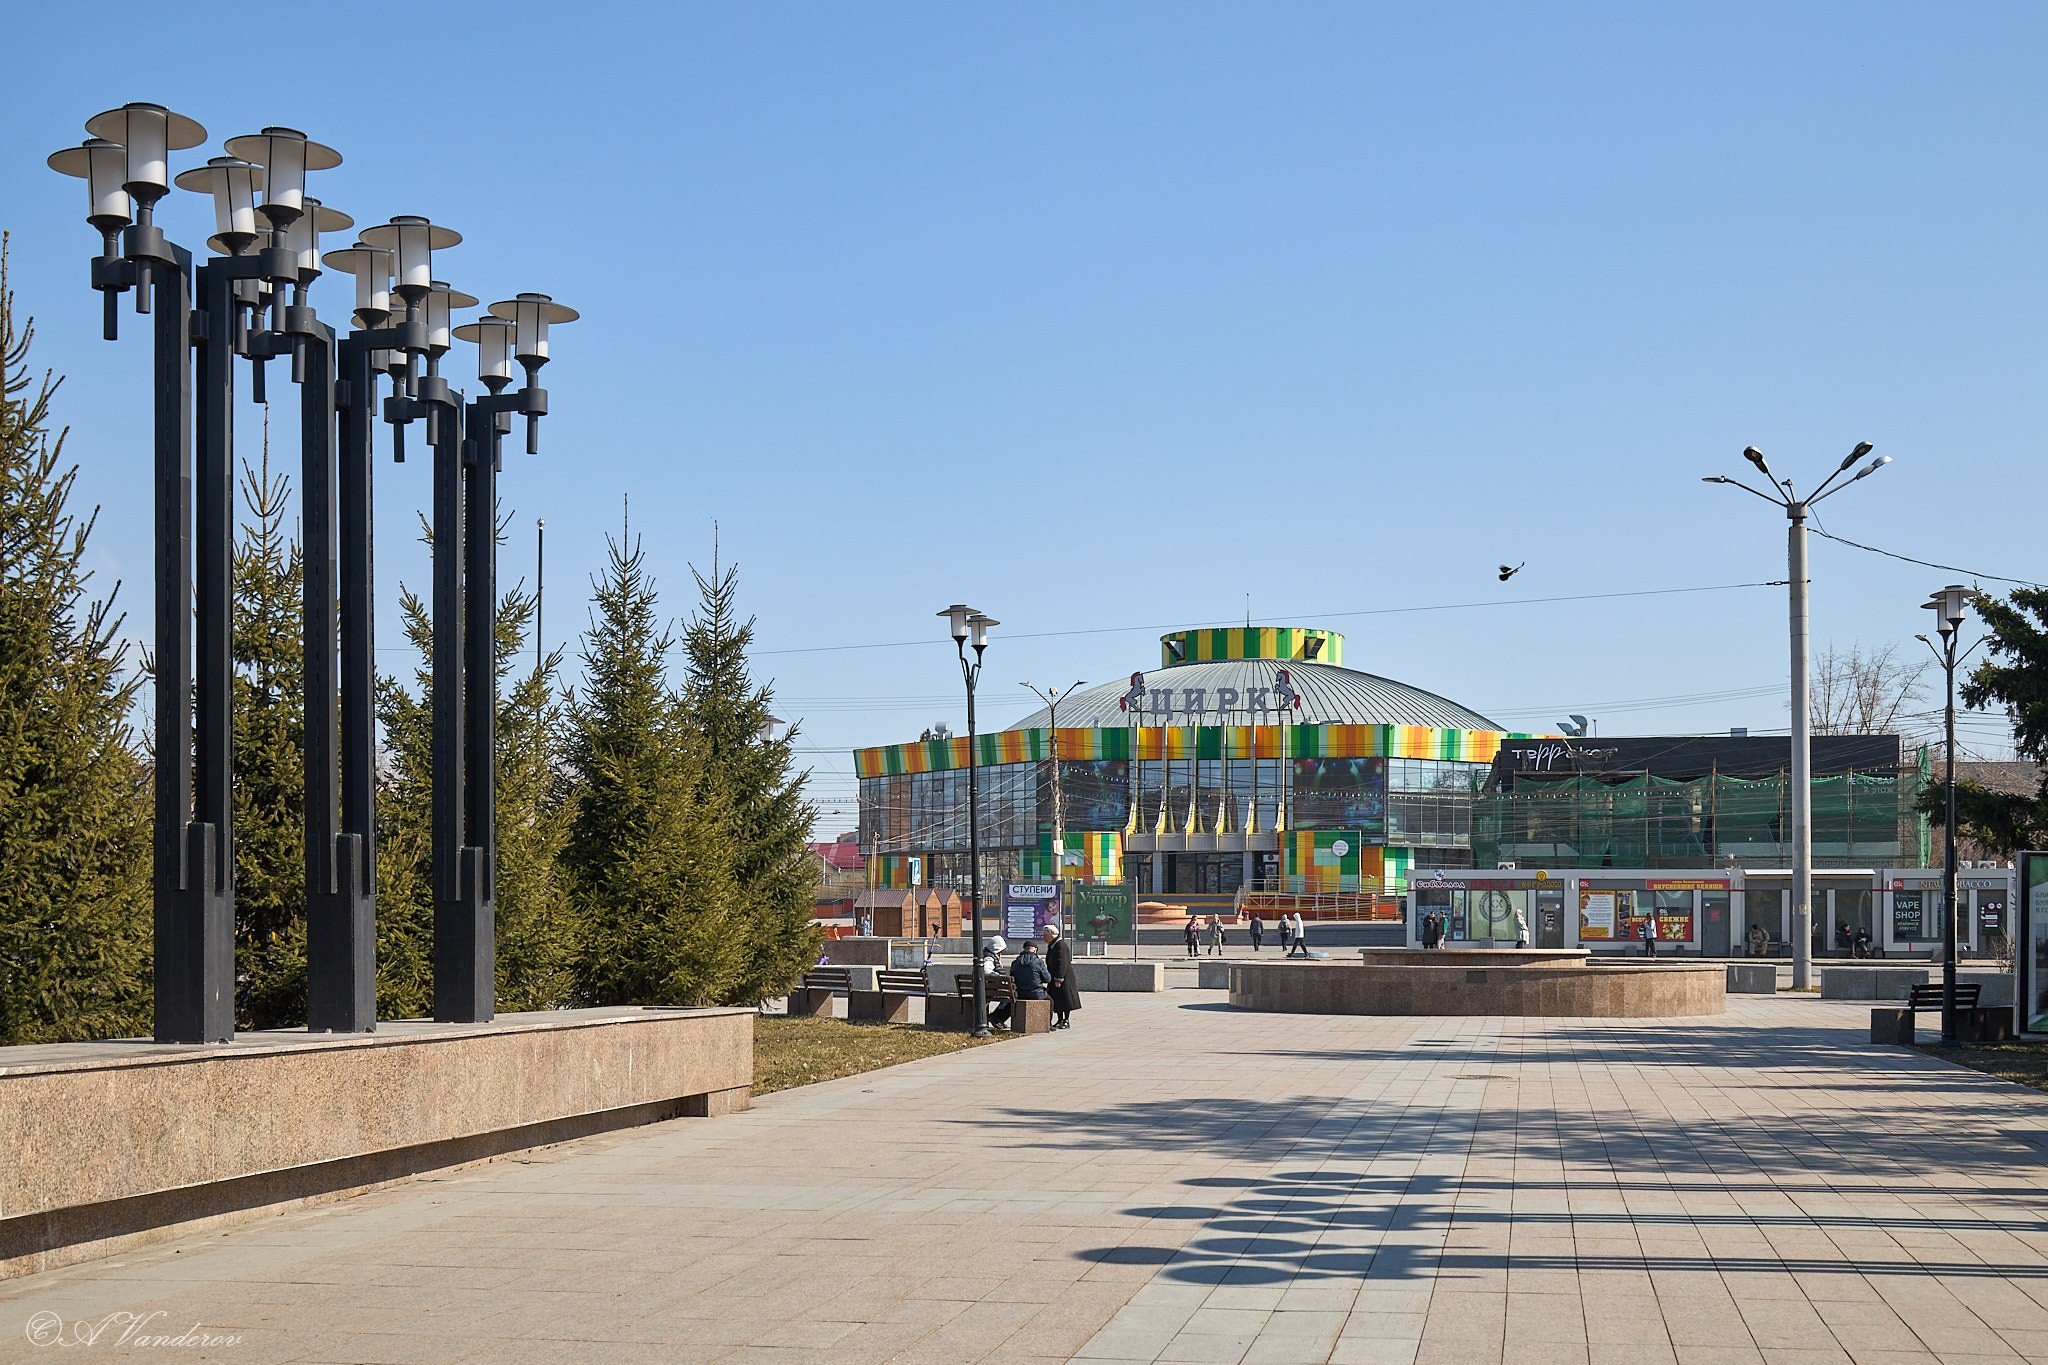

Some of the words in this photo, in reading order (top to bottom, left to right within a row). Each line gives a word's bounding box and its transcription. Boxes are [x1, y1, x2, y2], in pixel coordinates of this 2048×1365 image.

[1149, 687, 1270, 721] ЦИРК
[1470, 880, 1516, 889] ПРЕССА
[1920, 880, 1941, 889] NEW
[1012, 885, 1053, 894] СТУПЕНИ
[1080, 891, 1128, 908] Ульгер
[1896, 901, 1920, 909] VAPE
[1895, 911, 1921, 919] SHOP
